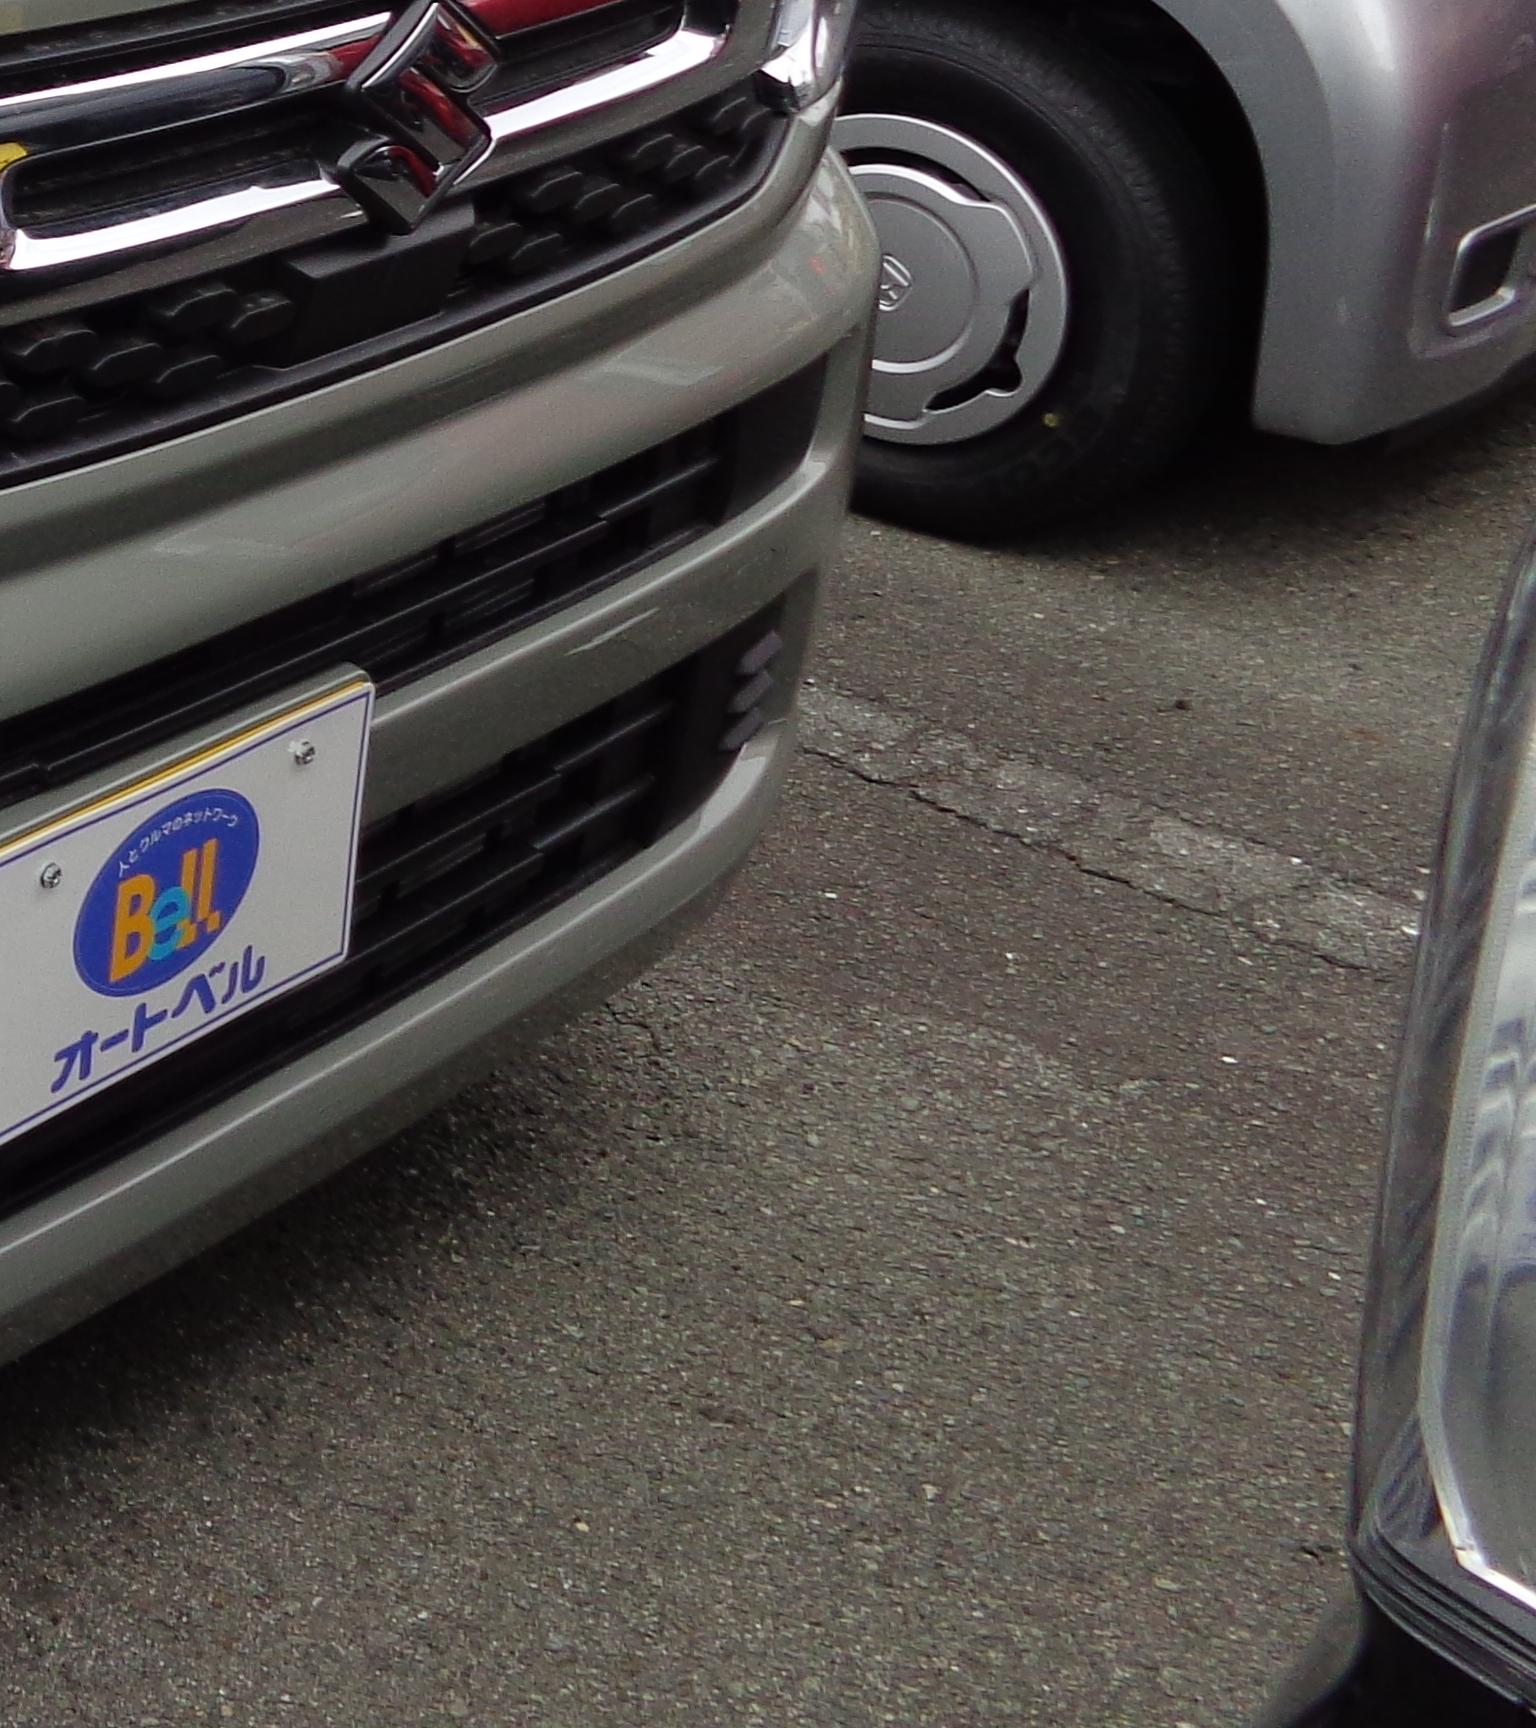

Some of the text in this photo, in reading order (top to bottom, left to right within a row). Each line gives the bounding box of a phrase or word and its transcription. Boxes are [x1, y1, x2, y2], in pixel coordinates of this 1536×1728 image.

[109, 837, 222, 983] Bell
[118, 806, 239, 878] 人とクルマのネットワーク
[50, 944, 267, 1094] オートベル
